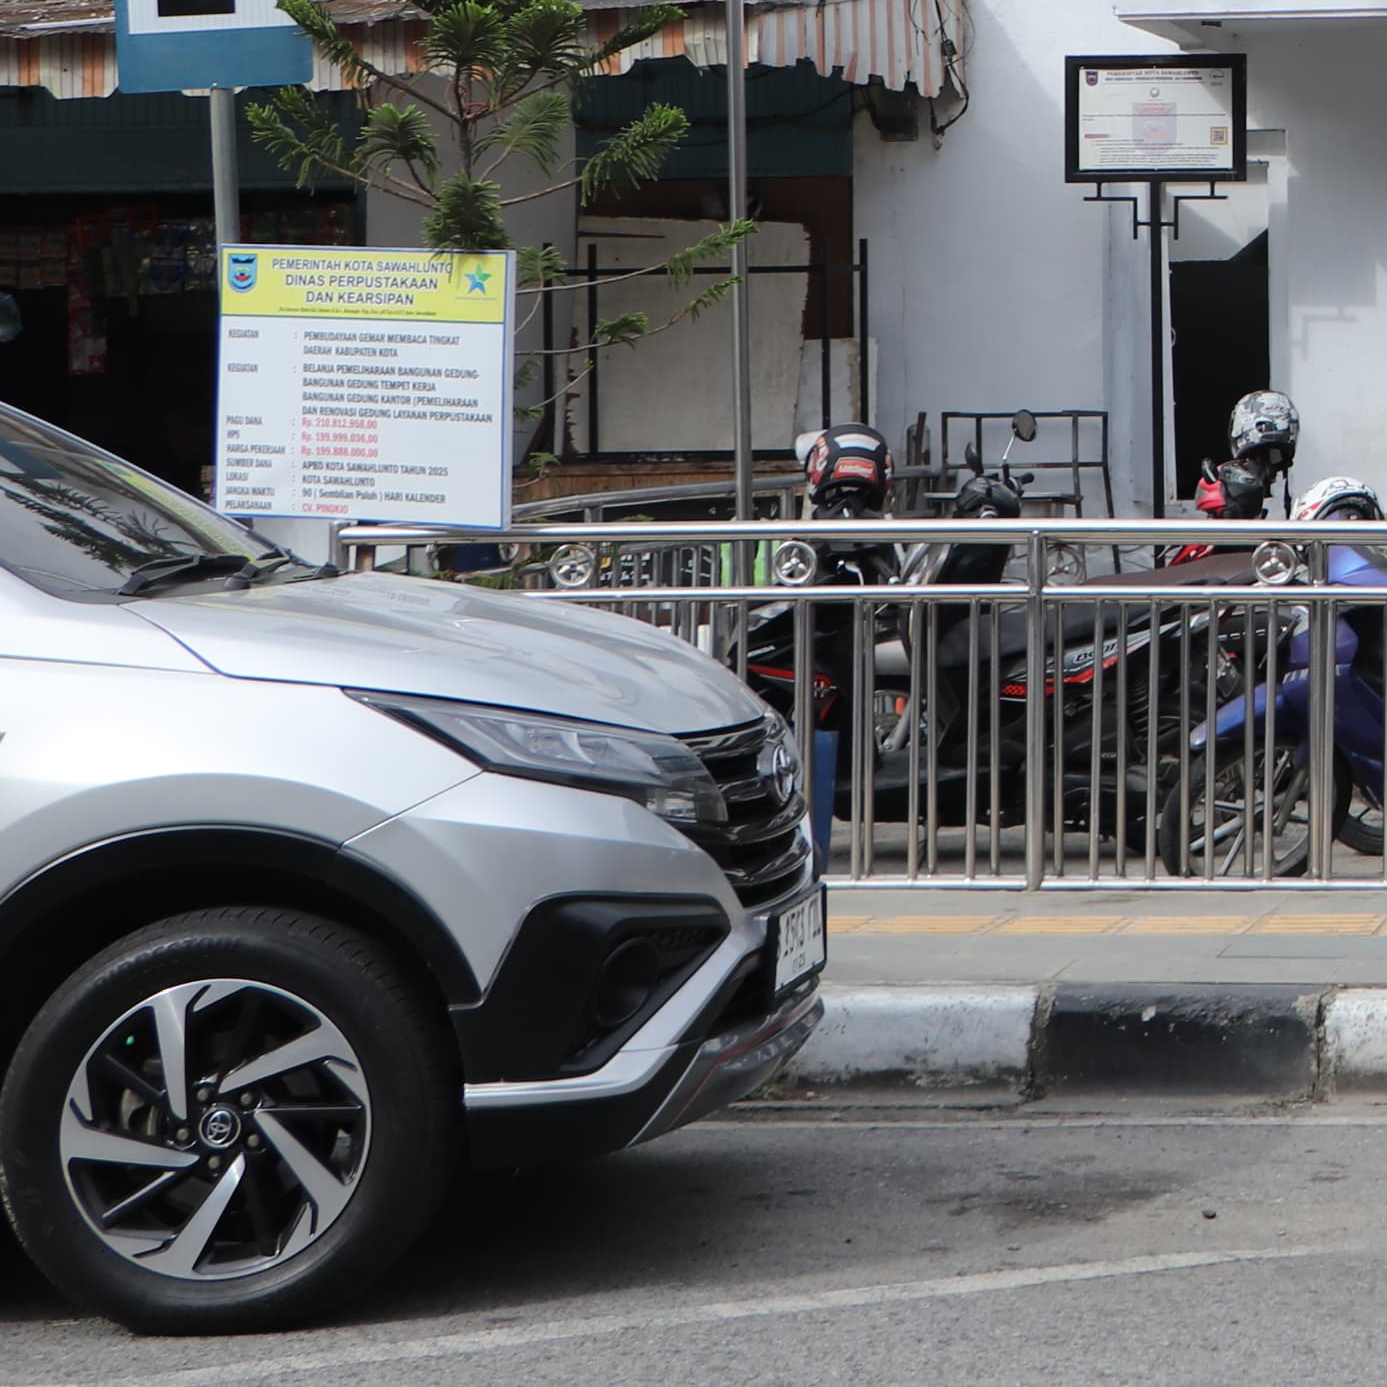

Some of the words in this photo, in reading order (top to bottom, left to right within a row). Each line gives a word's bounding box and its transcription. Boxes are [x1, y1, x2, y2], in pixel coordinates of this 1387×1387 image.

[272, 258, 341, 271] PEMERINTAH
[344, 260, 373, 272] KOTA
[377, 261, 453, 274] SAWAHLUNTO
[285, 274, 325, 286] DINAS
[329, 275, 438, 289] PERPUSTAKAAN
[306, 291, 333, 303] DAN
[338, 292, 414, 305] KEARSIPAN
[304, 331, 357, 342] PEMBUDAYAAN
[359, 333, 386, 343] GEMAR
[387, 334, 427, 344] MEMBACA
[429, 335, 460, 345] TINGKAT
[303, 345, 332, 355] DAERAH
[335, 346, 377, 356] KABUPATEN
[379, 347, 398, 357] KOTA
[303, 363, 334, 373] BELANJA
[336, 364, 396, 376] PEMELIHARAAN
[303, 377, 344, 388] BANGUNAN
[347, 379, 378, 389] GEDUNG
[412, 382, 436, 392] KERJA
[347, 393, 379, 403] GEDUNG
[380, 395, 411, 405] KANTOR
[302, 405, 317, 415] DAN
[319, 406, 357, 417] RENOVASI
[359, 408, 391, 418] GEDUNG
[393, 409, 427, 420] LAYANAN
[429, 411, 492, 423] PERPUSTAKAAN
[325, 462, 344, 471] KOTA
[346, 462, 399, 474] SAWAHLUNTO
[400, 464, 426, 475] TAHUN
[302, 475, 321, 485] KOTA
[322, 476, 375, 487] SAWAHLUNTO
[319, 488, 354, 499] Sembilan
[384, 491, 403, 502] HARI
[405, 492, 446, 504] KALENDER
